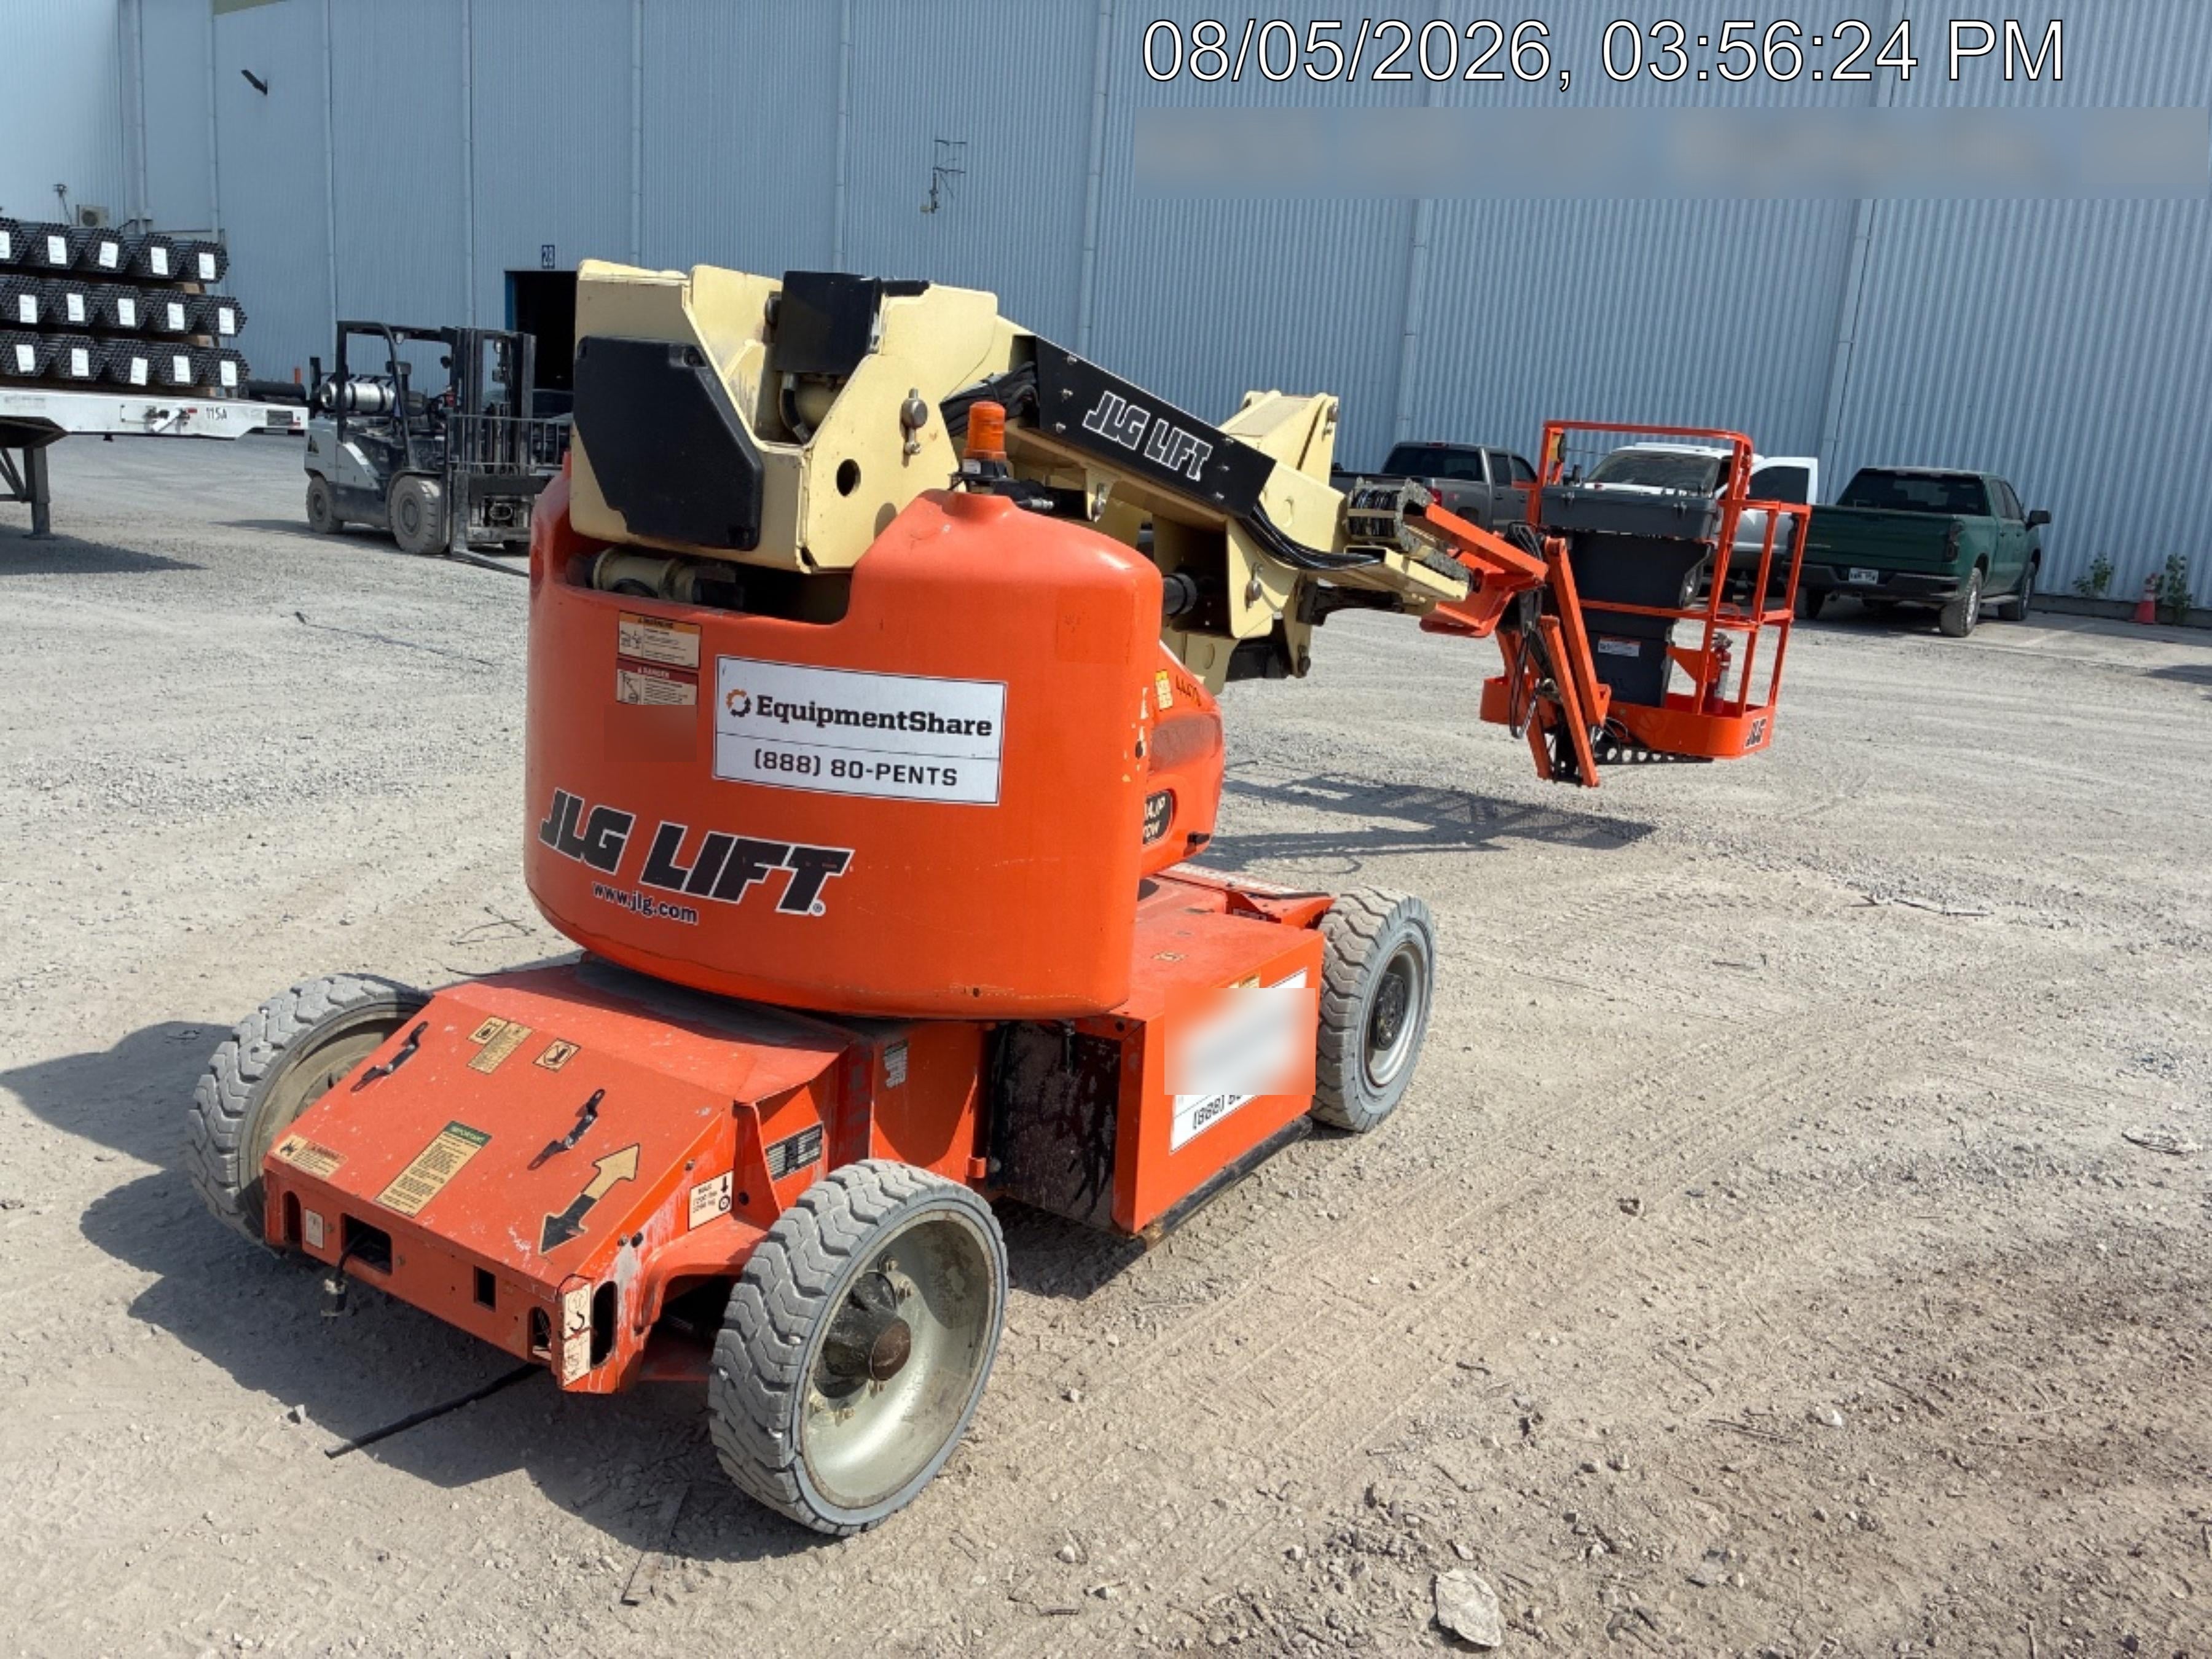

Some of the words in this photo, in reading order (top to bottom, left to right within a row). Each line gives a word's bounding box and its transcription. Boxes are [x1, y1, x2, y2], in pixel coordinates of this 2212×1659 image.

[1082, 390, 1151, 450] JLG
[1143, 418, 1213, 481] LIFT
[756, 694, 992, 737] EquipmentShare
[755, 748, 821, 777] (888)
[830, 759, 958, 786] 80-PENTS
[538, 787, 637, 876] JLG
[639, 820, 855, 915] LIFT
[592, 881, 699, 925] www.jlg.com
